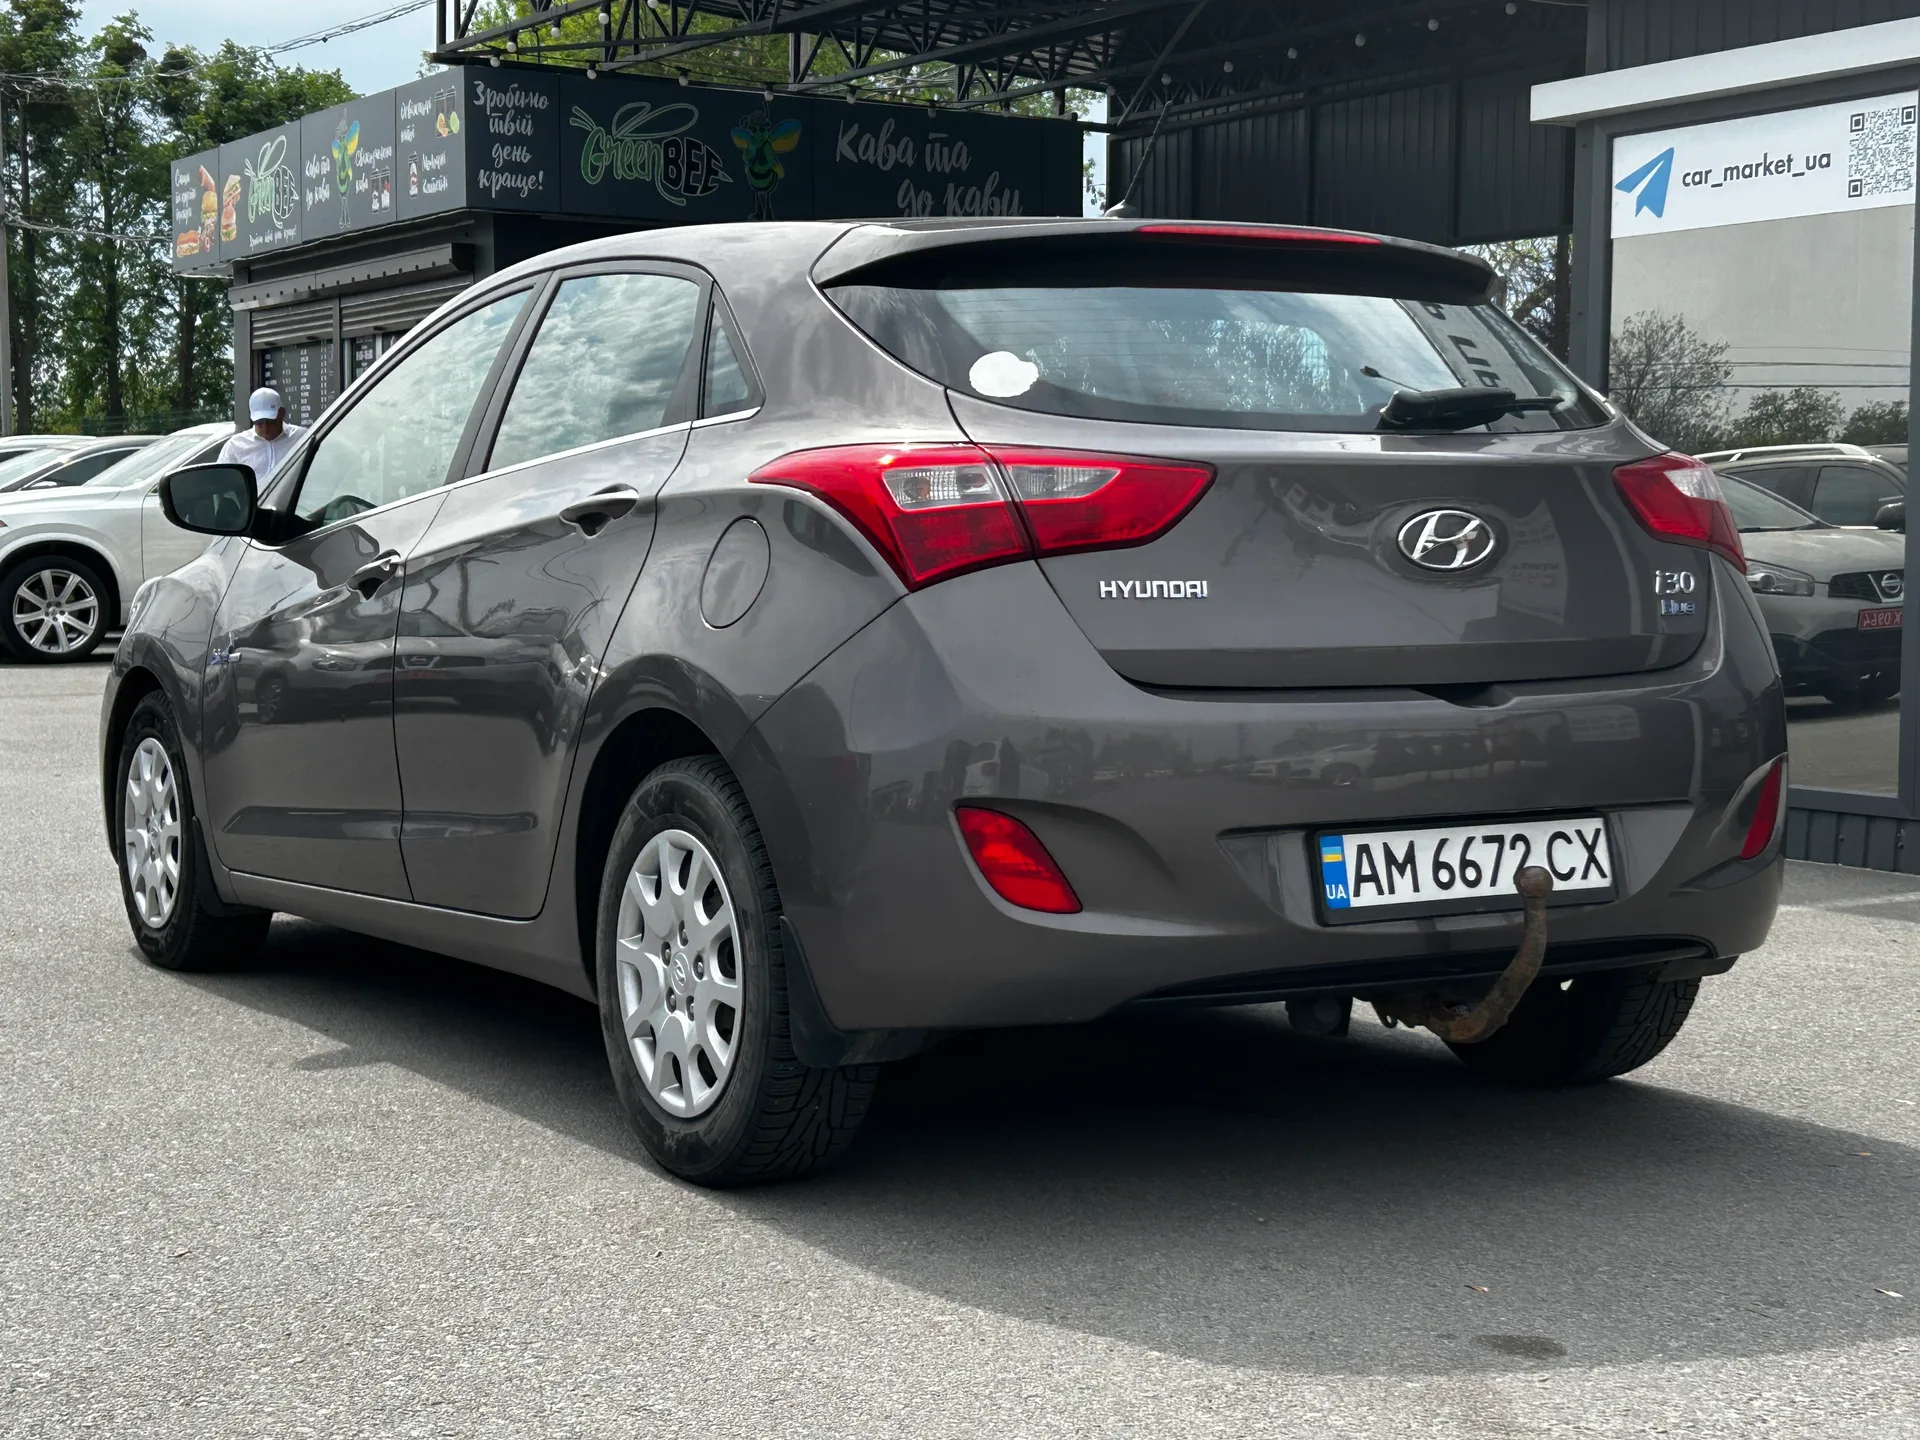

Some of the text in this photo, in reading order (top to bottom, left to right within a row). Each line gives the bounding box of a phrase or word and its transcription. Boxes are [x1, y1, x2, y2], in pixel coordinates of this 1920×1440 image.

[474, 80, 550, 115] Зробимо
[489, 109, 534, 136] твій
[491, 142, 533, 168] день
[836, 117, 972, 173] Кава та
[478, 168, 544, 198] краще!
[1682, 152, 1831, 188] car_market_ua
[896, 171, 1024, 217] до кави
[1099, 580, 1208, 598] HYUNDAI
[1655, 570, 1695, 595] i30
[1353, 828, 1609, 897] AM 6672 CX
[1326, 884, 1347, 900] UA
